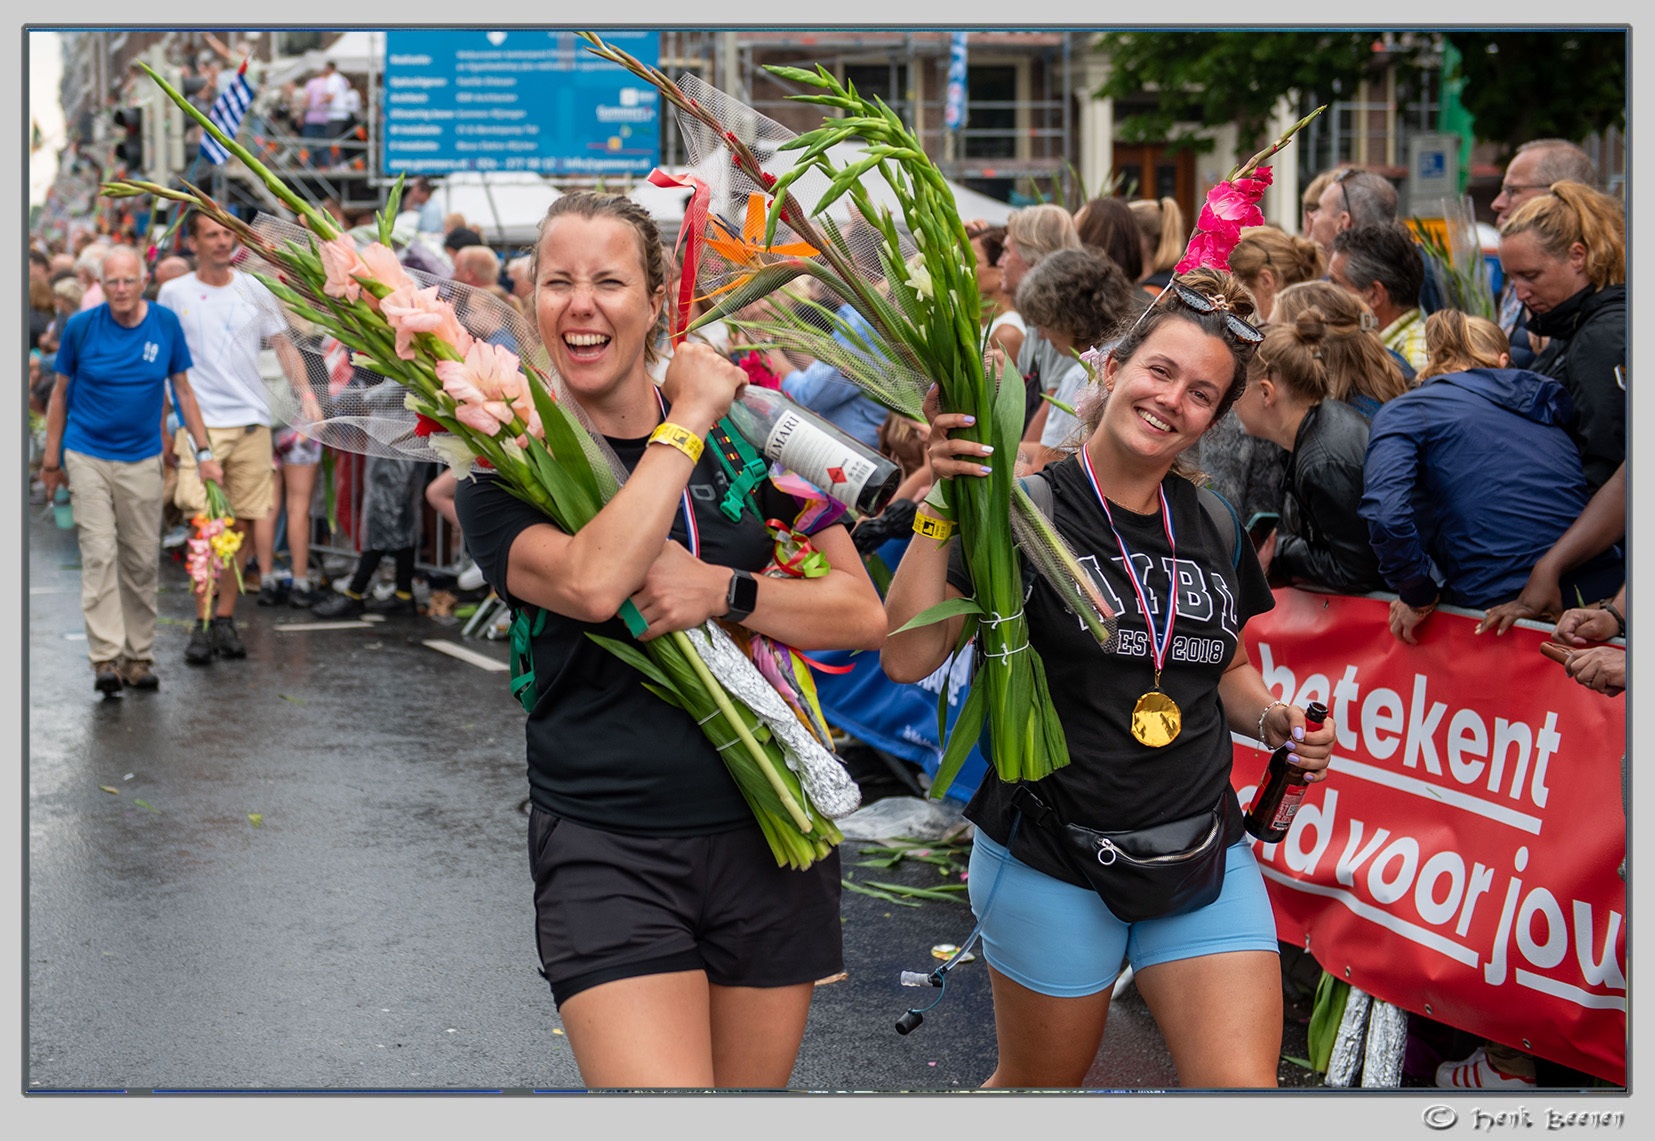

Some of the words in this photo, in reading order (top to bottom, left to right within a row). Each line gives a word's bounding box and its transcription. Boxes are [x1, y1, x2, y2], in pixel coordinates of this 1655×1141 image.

[1116, 629, 1166, 657] ES
[1171, 635, 1225, 664] 2018
[1335, 818, 1496, 938] voor
